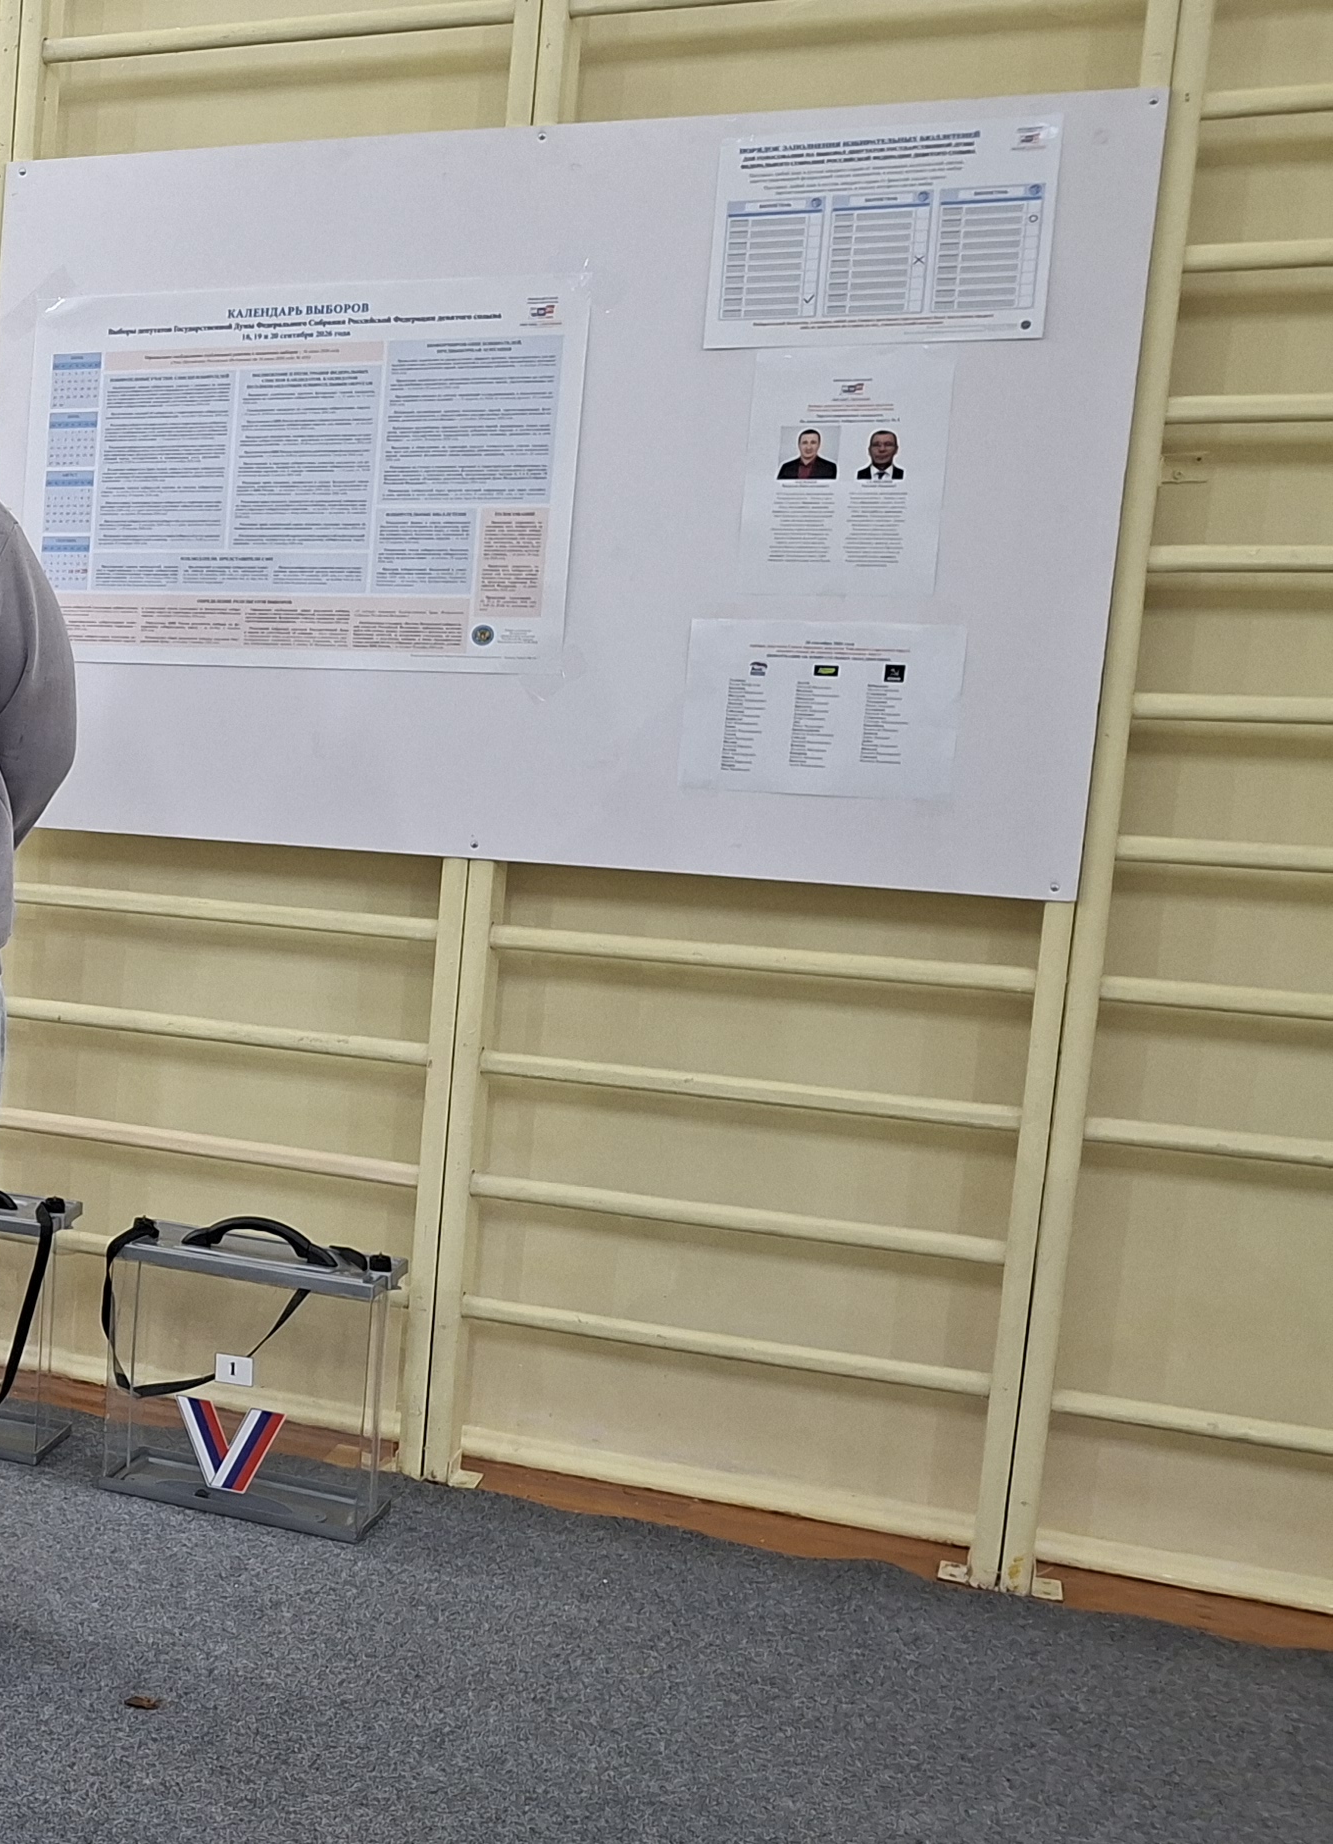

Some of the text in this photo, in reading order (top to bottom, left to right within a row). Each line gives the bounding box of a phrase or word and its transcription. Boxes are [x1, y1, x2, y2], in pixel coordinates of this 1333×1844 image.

[227, 303, 370, 319] КАЛЕНДАРЬ ВЫБОРОВ
[229, 1361, 237, 1376] 1
